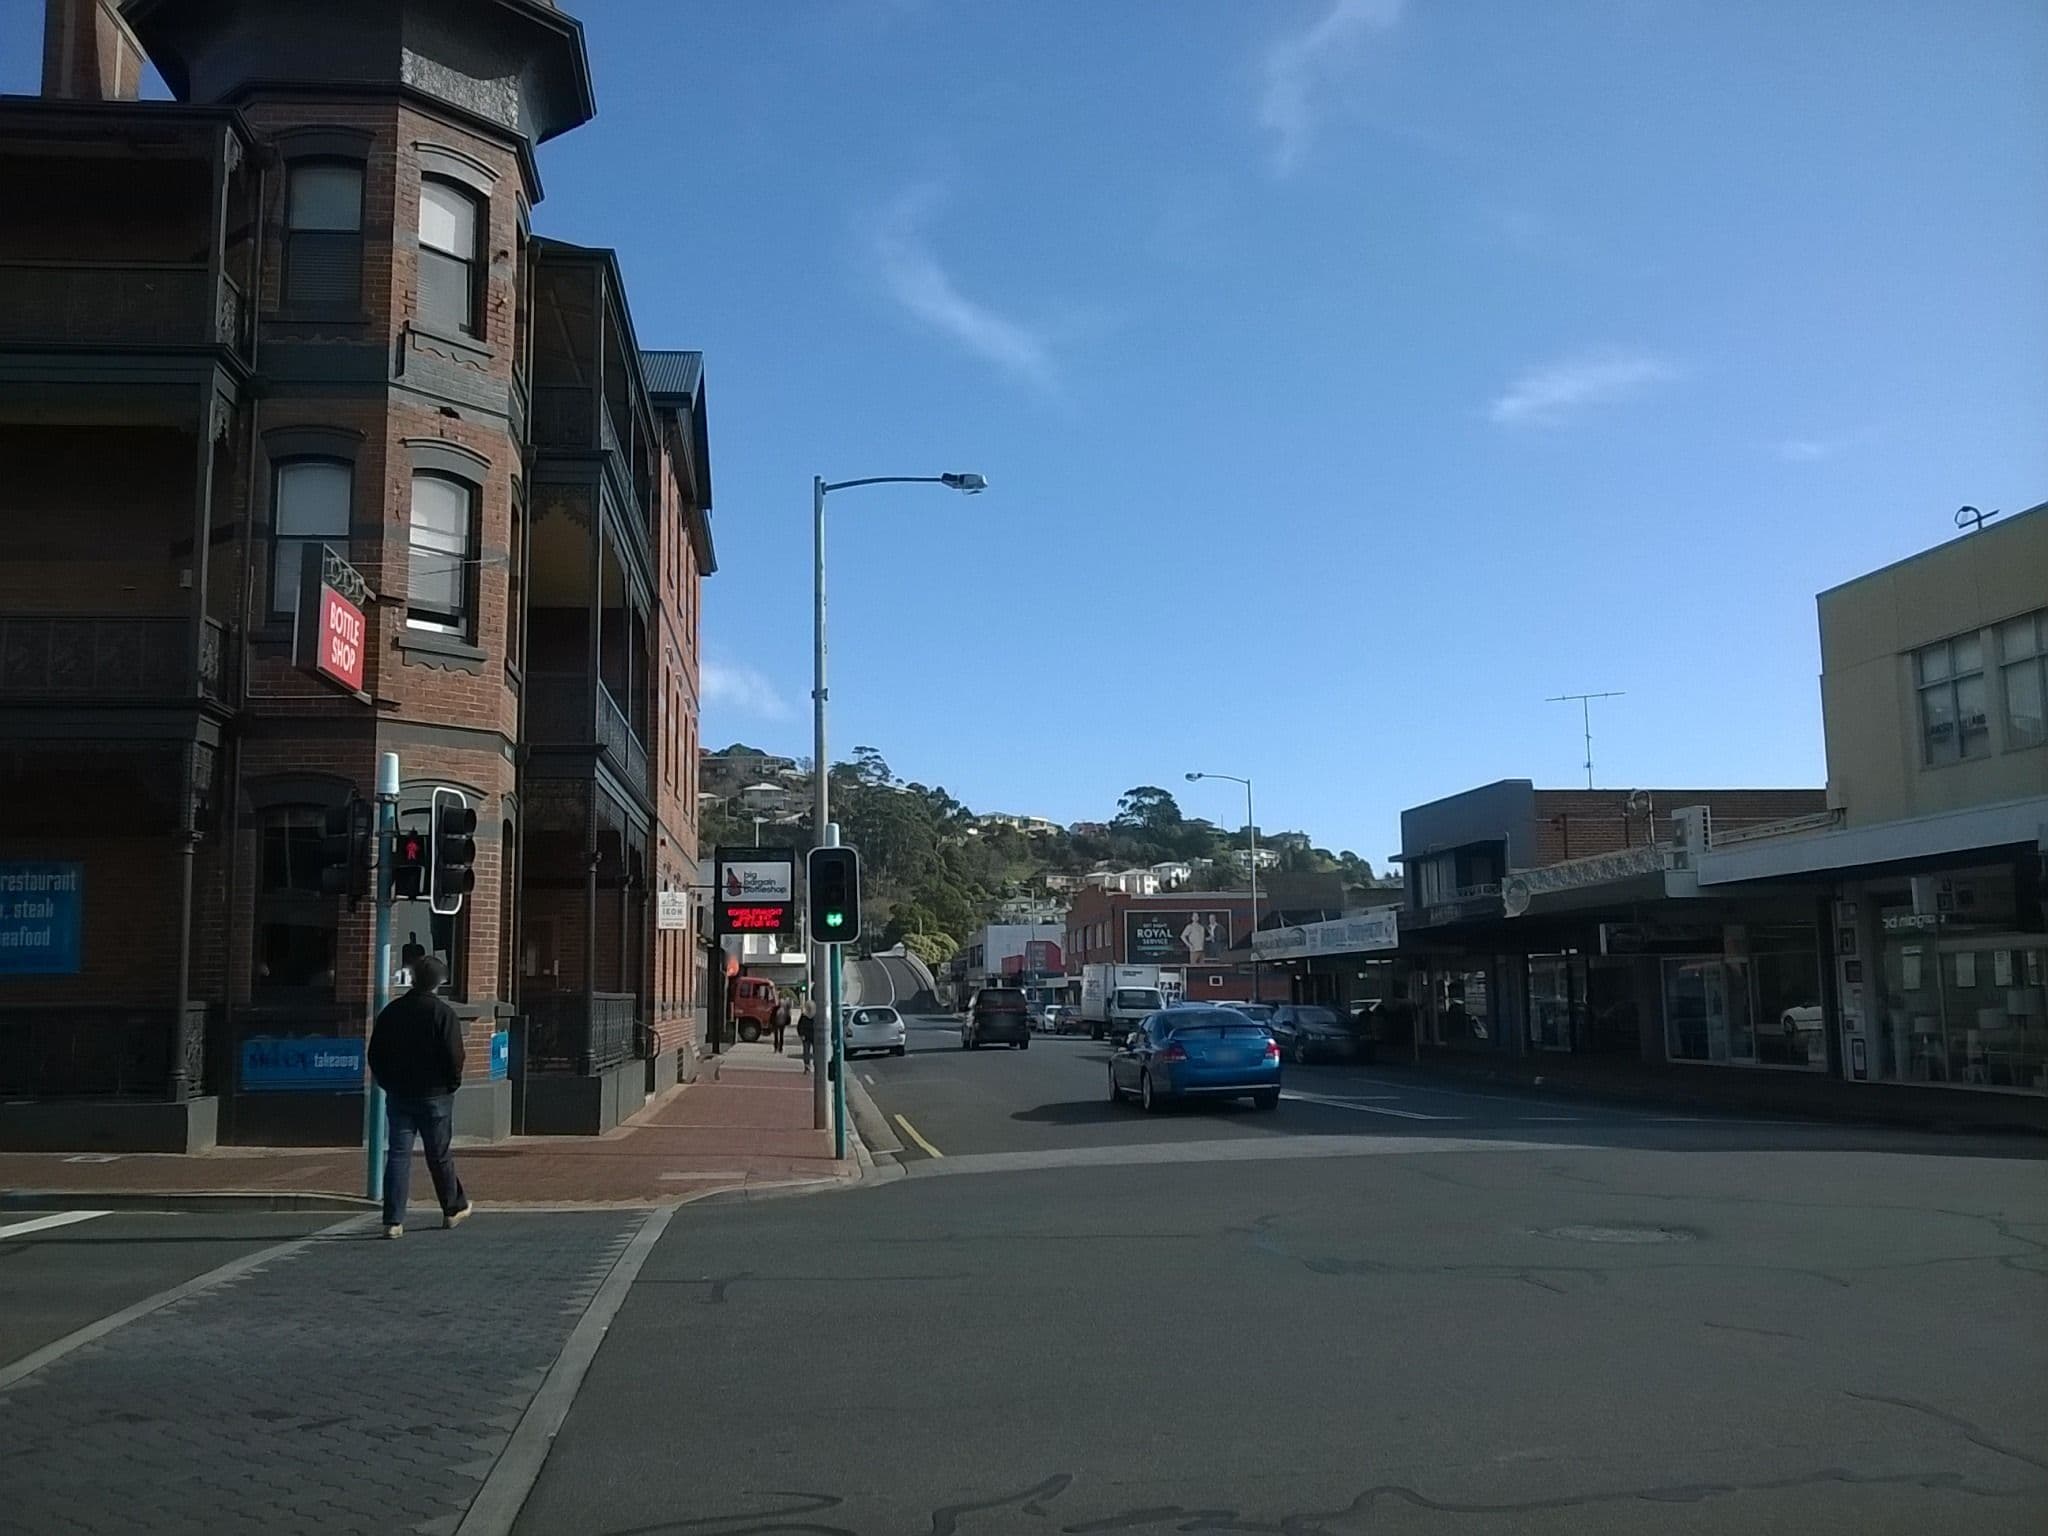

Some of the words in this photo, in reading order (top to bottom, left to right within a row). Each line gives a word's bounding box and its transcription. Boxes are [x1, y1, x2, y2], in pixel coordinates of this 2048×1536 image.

[329, 601, 361, 648] BOTTLE
[331, 635, 357, 674] SHOP
[0, 871, 77, 892] restaurant
[743, 870, 757, 879] big
[743, 878, 776, 888] bargain
[13, 897, 55, 919] steak
[1136, 928, 1174, 938] ROYAL
[313, 1051, 360, 1071] takeaway
